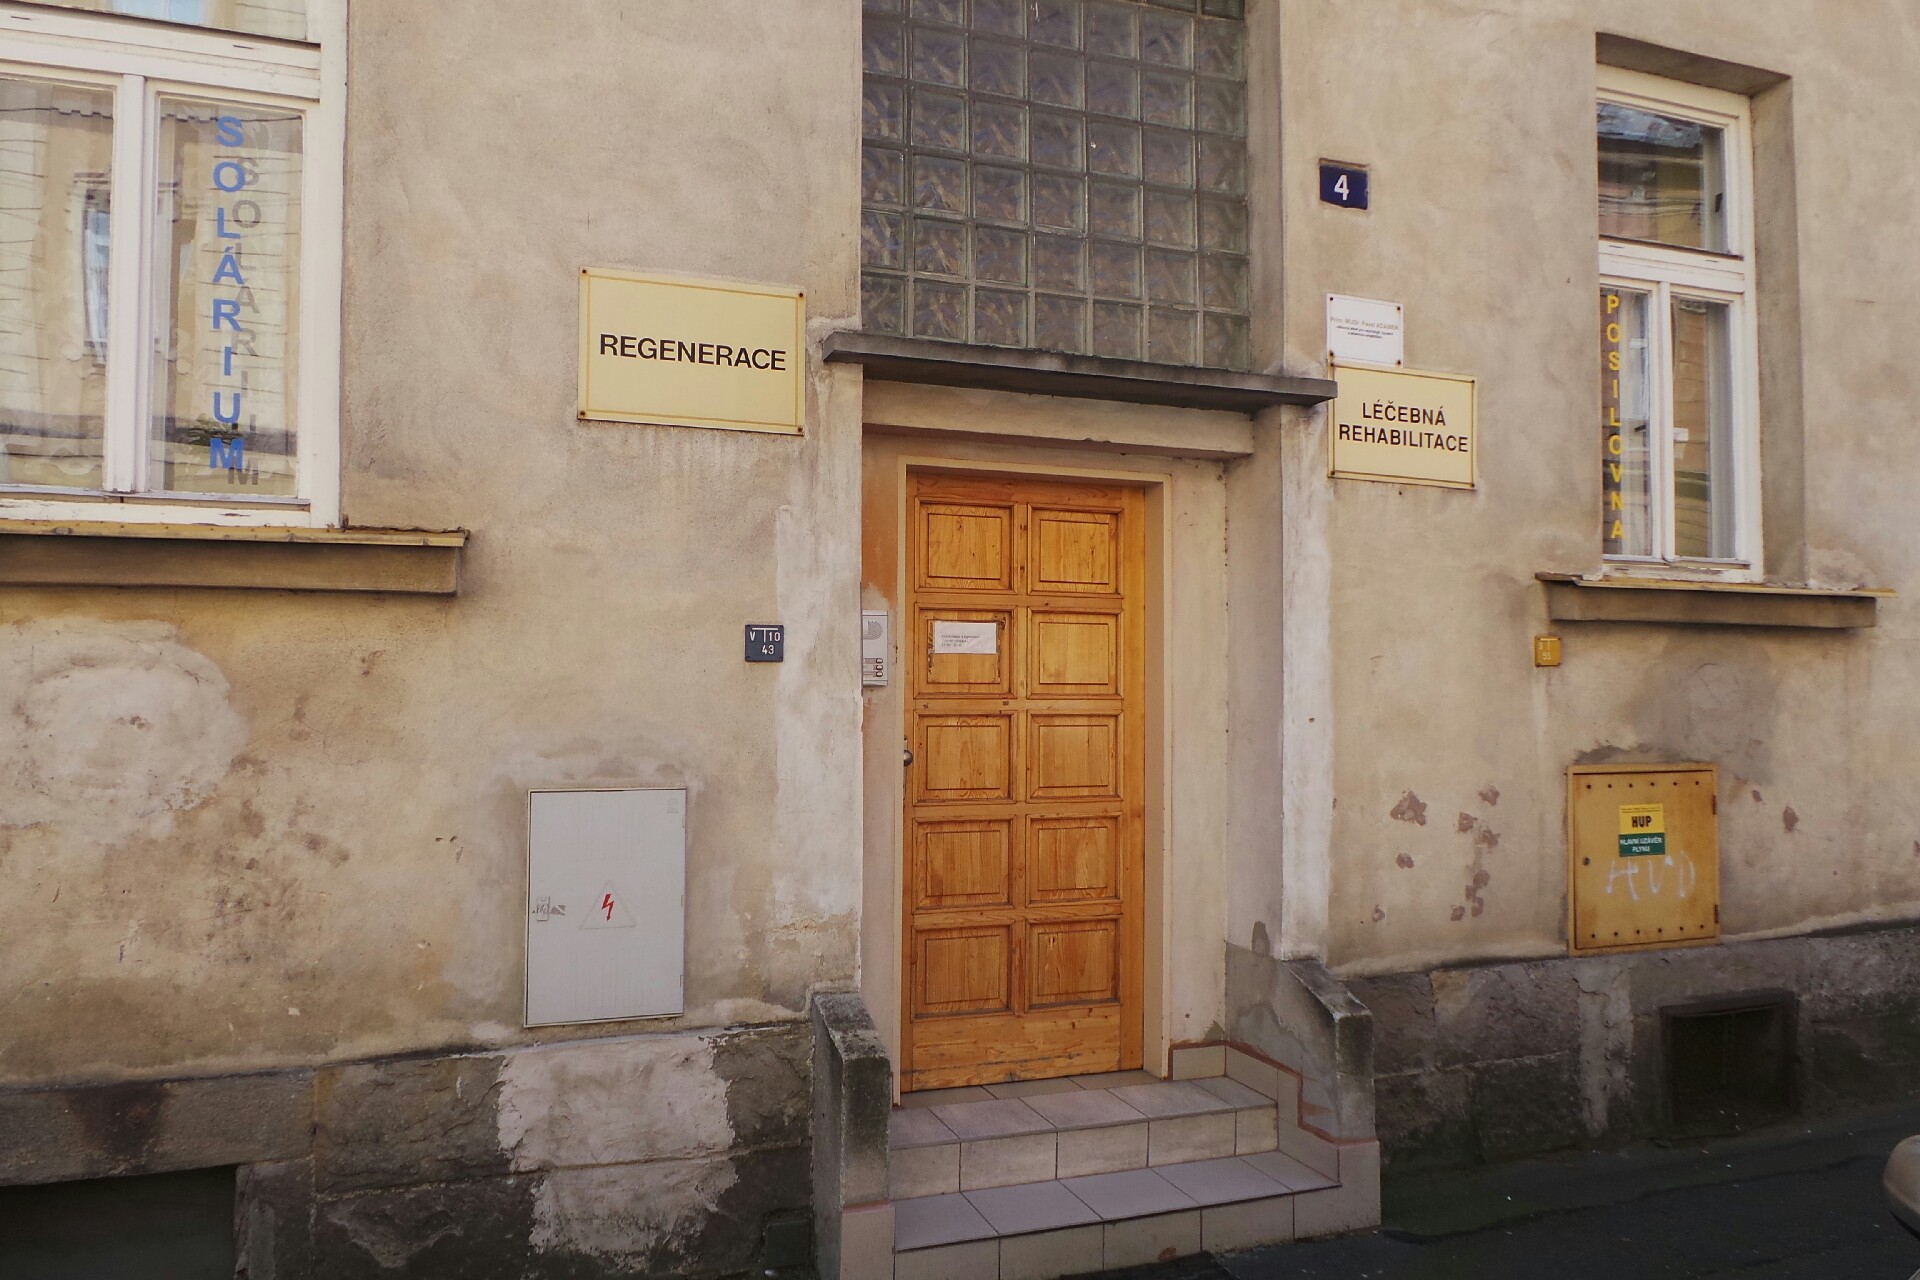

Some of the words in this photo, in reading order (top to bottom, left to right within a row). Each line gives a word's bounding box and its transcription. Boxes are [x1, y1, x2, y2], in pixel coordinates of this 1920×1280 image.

[1334, 174, 1350, 201] 4
[209, 116, 246, 470] SOLÁRIUM
[600, 334, 786, 371] REGENERACE
[1362, 399, 1446, 426] LÉČEBNÁ
[1606, 295, 1627, 539] POSILOVNA
[1339, 424, 1468, 453] REHABILITACE
[749, 631, 756, 642] V
[768, 631, 781, 642] 10
[761, 645, 775, 655] 43
[1631, 815, 1652, 828] HUP
